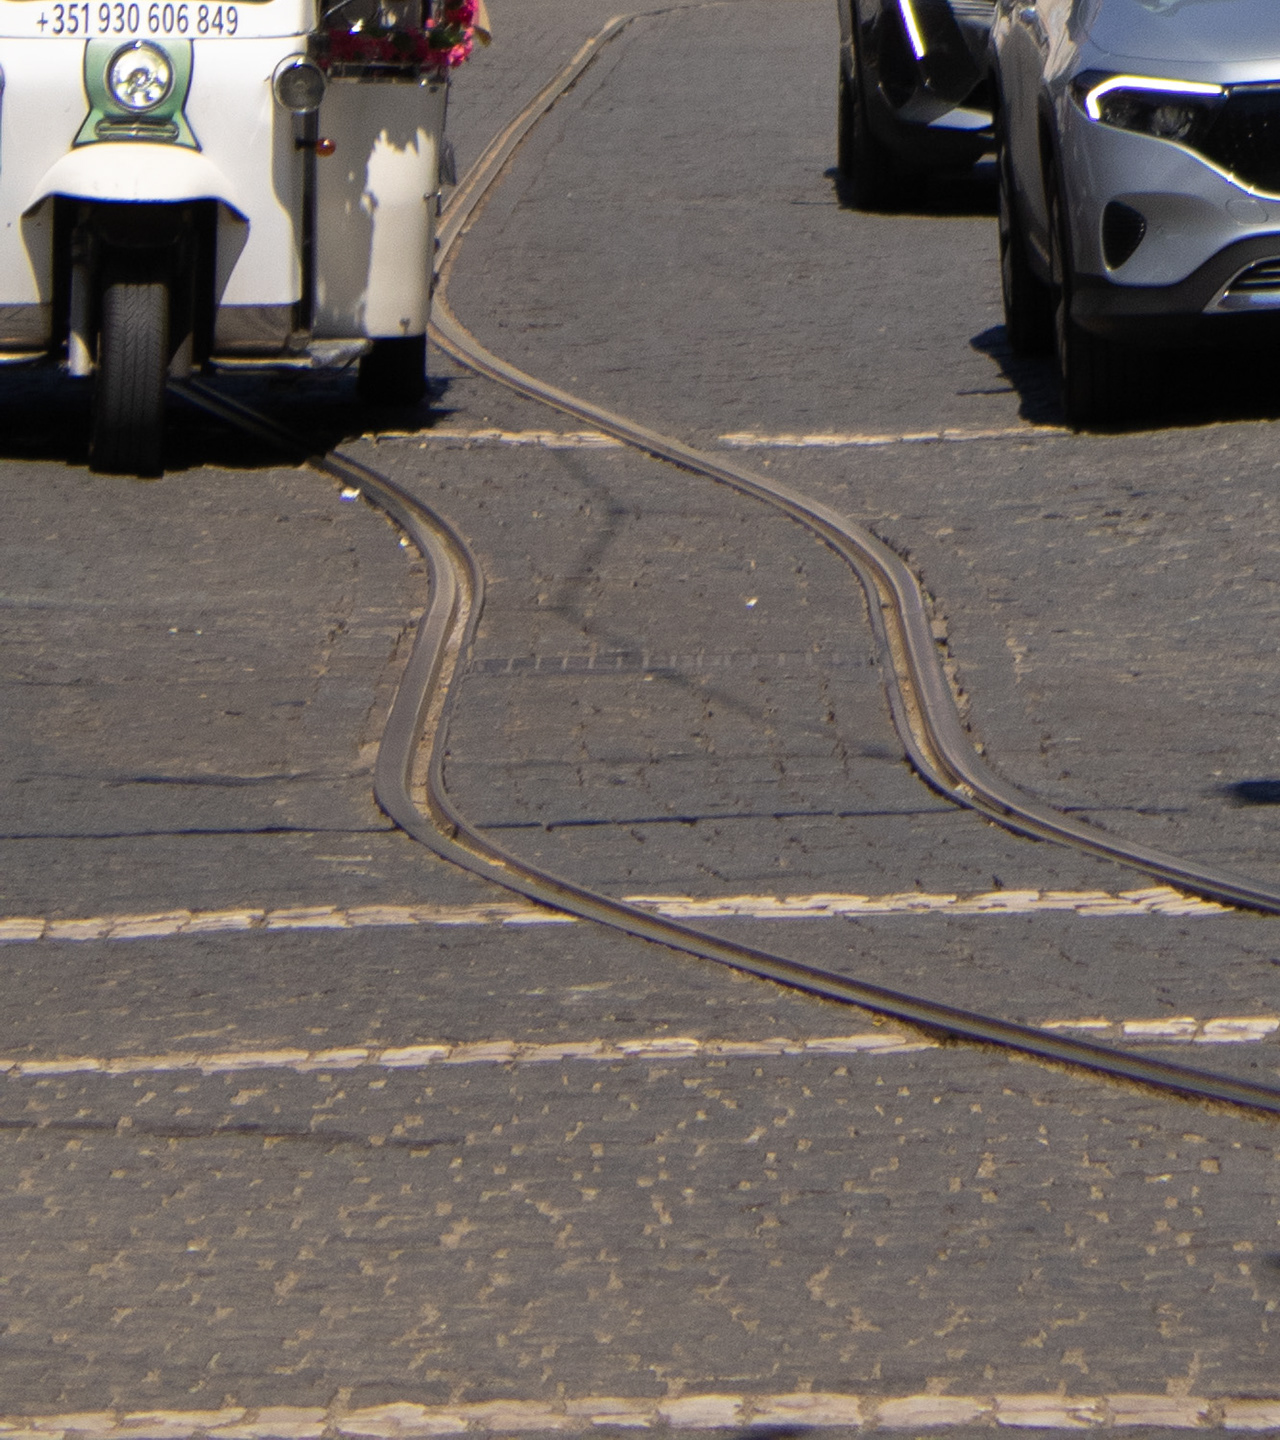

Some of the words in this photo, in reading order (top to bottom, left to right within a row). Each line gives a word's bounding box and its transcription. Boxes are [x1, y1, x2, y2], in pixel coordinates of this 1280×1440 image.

[37, 2, 90, 35] +351
[98, 2, 140, 33] 930
[148, 2, 189, 34] 606
[197, 4, 238, 36] 849
